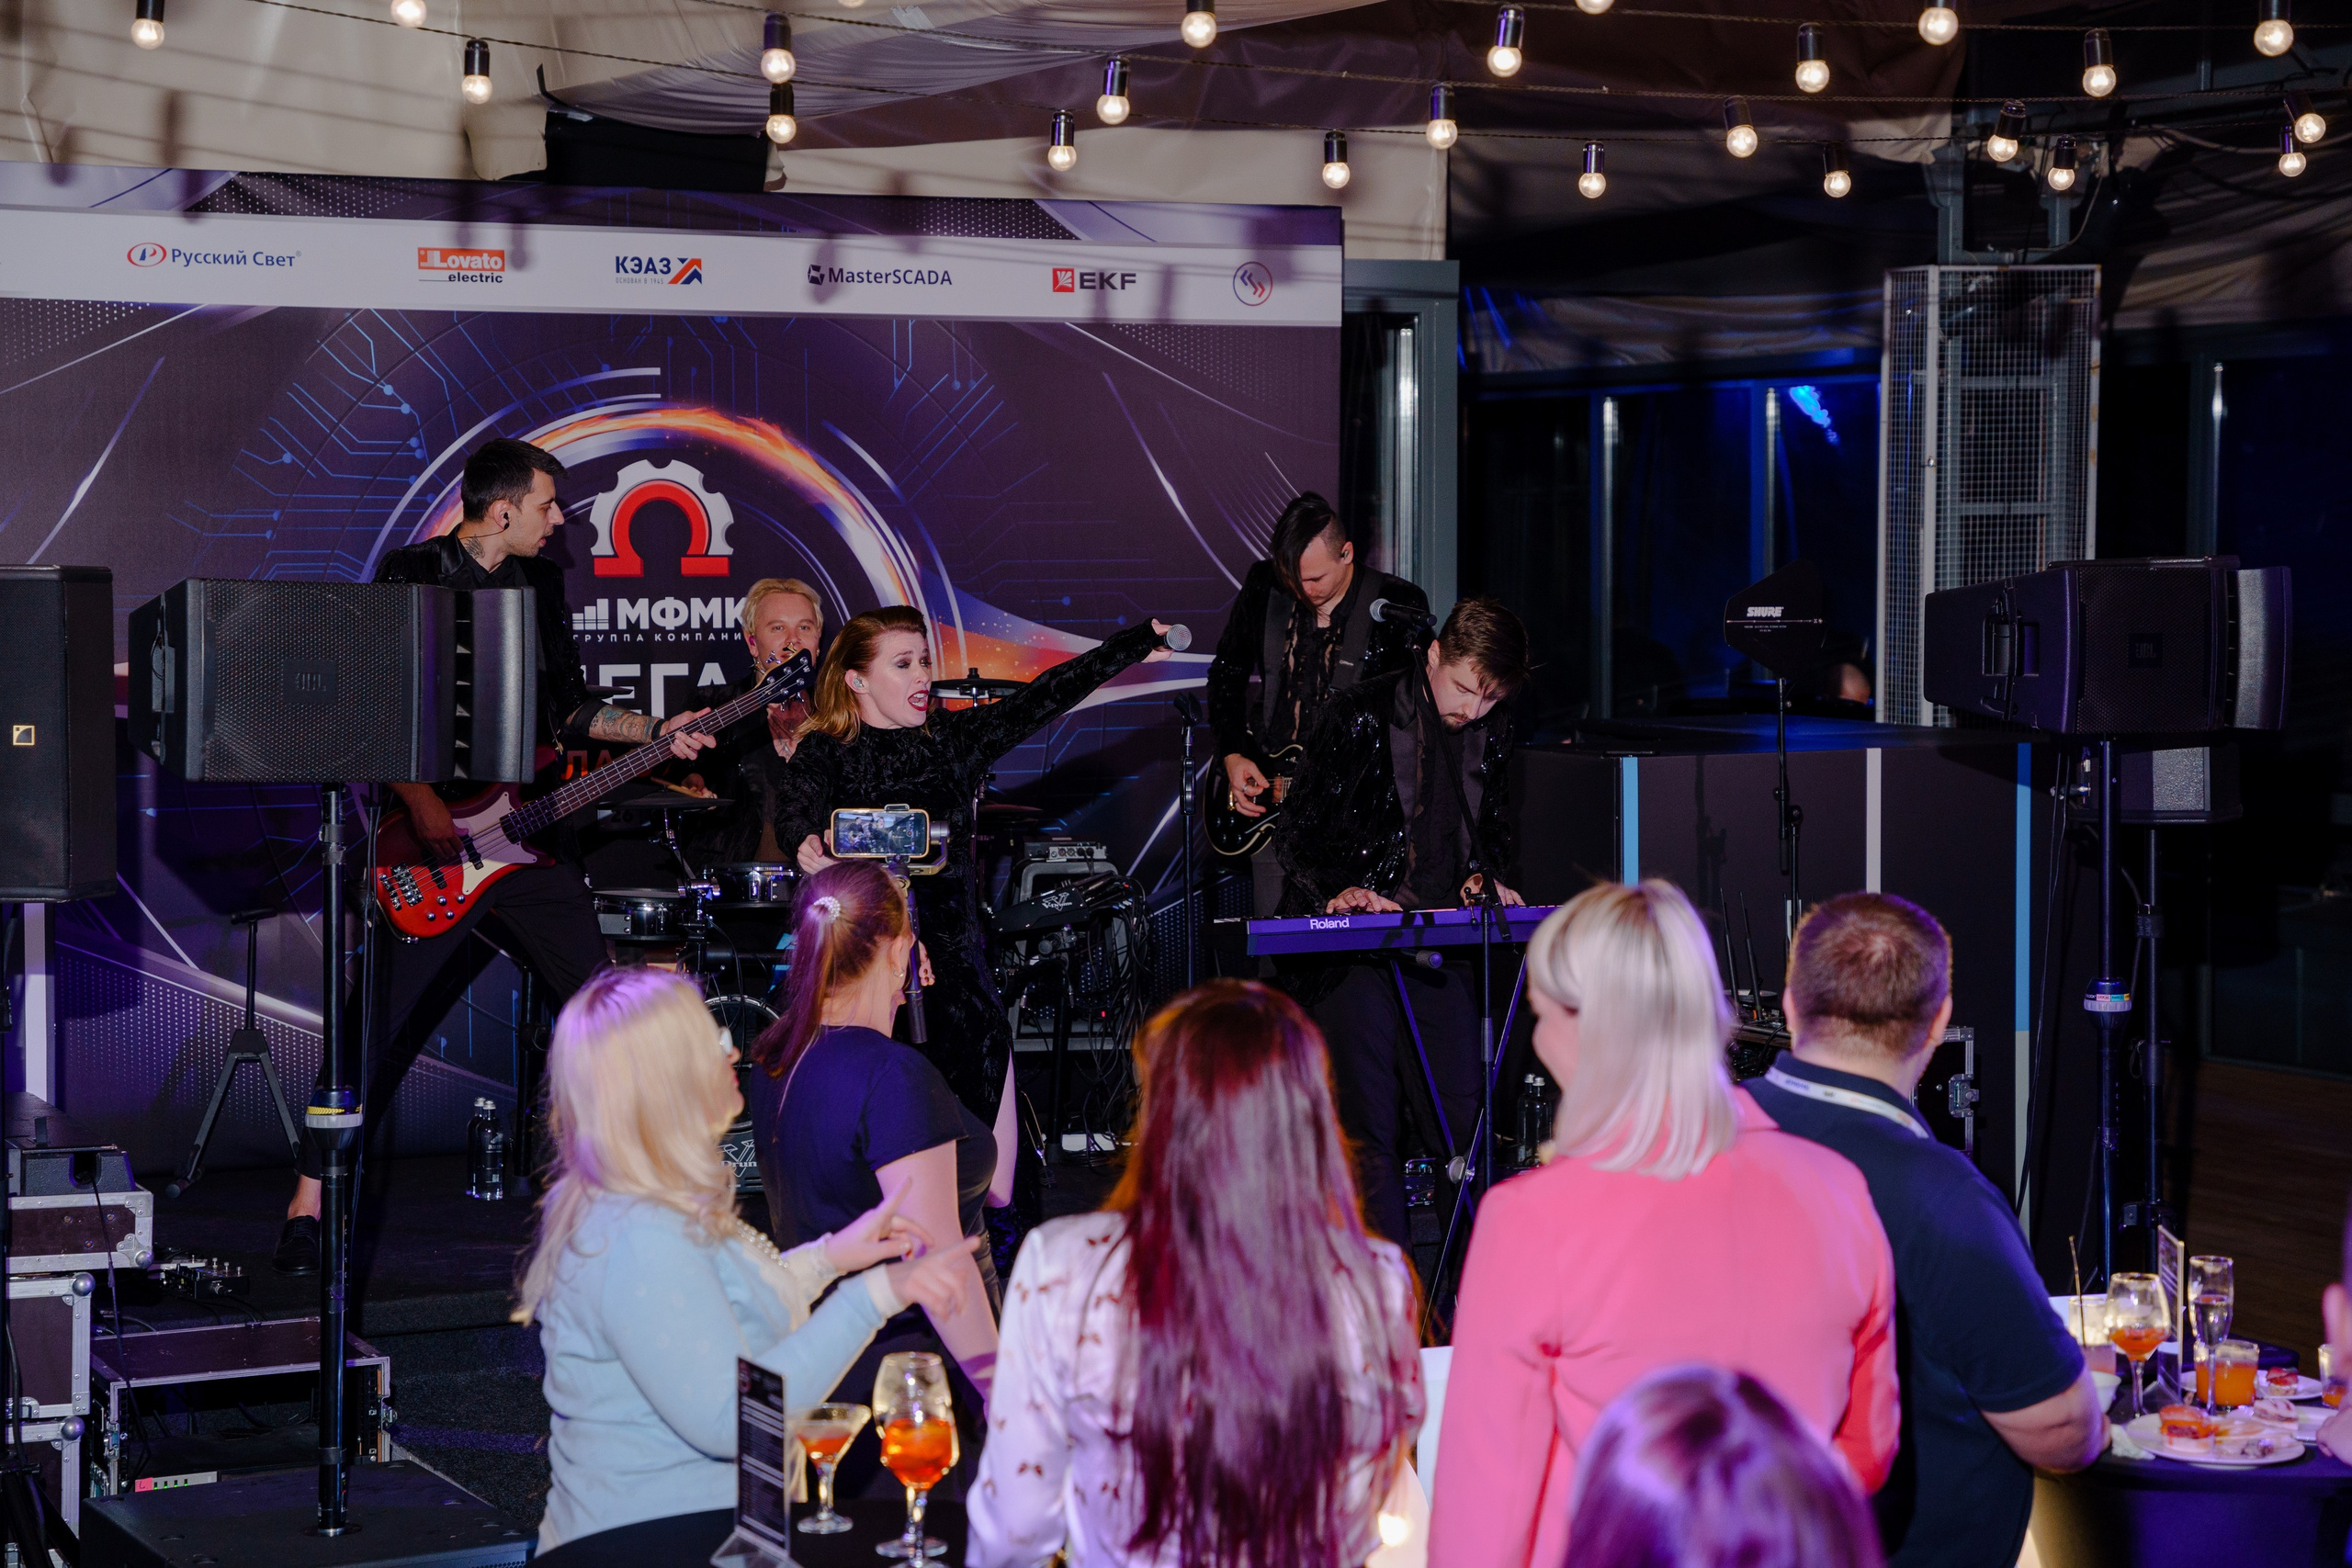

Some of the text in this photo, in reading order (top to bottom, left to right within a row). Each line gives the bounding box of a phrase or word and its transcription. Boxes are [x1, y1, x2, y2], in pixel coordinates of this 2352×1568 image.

[171, 248, 247, 267] Русский
[433, 250, 503, 270] Lovato
[615, 255, 672, 275] КЭАЗ
[447, 272, 503, 284] electric
[828, 267, 953, 287] MasterSCADA
[1079, 271, 1137, 291] EKF
[616, 596, 743, 631] МФМК
[1747, 606, 1784, 618] SHURE
[654, 632, 741, 642] КОМПАНИ
[1309, 917, 1351, 930] Roland
